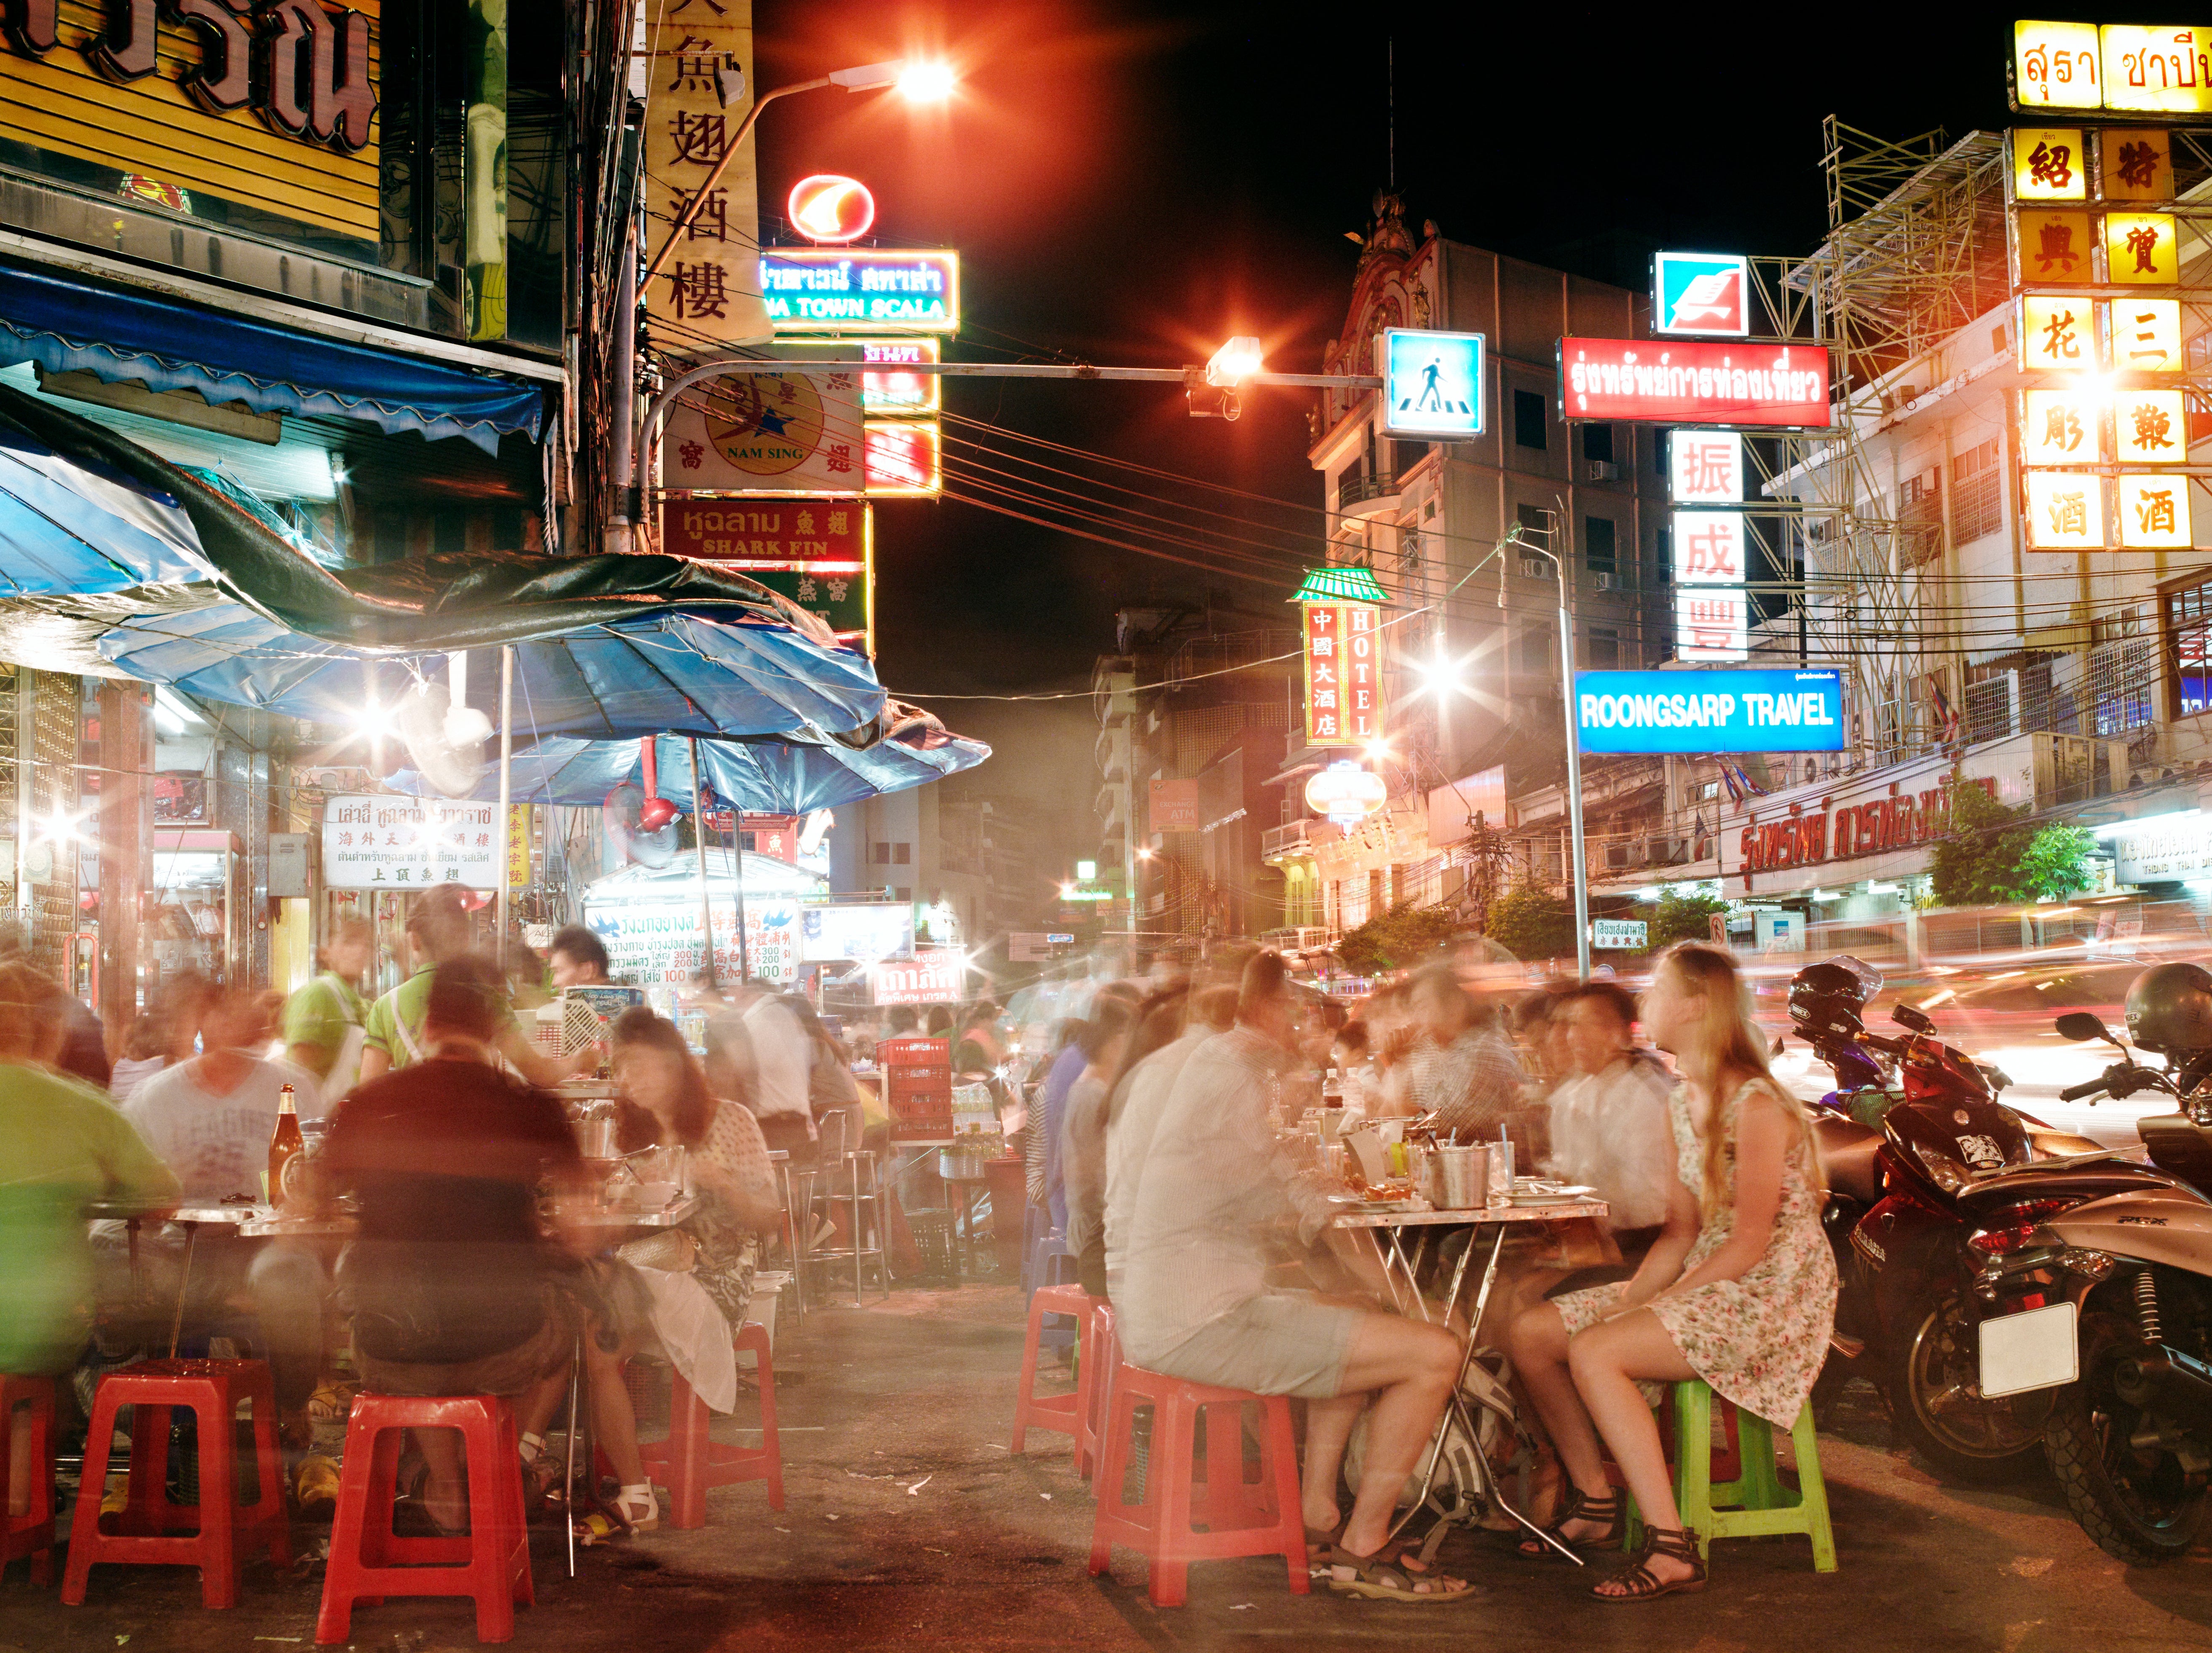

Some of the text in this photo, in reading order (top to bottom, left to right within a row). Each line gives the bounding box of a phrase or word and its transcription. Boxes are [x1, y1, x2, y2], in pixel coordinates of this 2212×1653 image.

[2025, 43, 2095, 100] สุรา
[765, 297, 945, 318] NA TOWN SCALA
[1571, 347, 1820, 410] รุ่งทรัพย์การท่องเที่ยว
[727, 447, 803, 459] NAM SING
[683, 512, 780, 540] หูฉลาม
[703, 540, 828, 556] SHARK FIN
[1313, 610, 1337, 737] 中國大酒店
[1352, 611, 1371, 736] HOTEL
[1580, 692, 1834, 728] ROONGSARP TRAVEL
[439, 806, 492, 825] ยาวราช
[1170, 809, 1195, 820] ATM
[338, 831, 490, 847] 海外天魚酒樓
[767, 834, 783, 860] 魚
[2142, 863, 2169, 874] THONG
[2175, 859, 2194, 871] THAI
[674, 951, 692, 959] 300
[762, 947, 779, 955] 300
[674, 959, 692, 968] 200
[762, 955, 779, 964] 200
[664, 970, 686, 982] 100
[758, 965, 779, 978] 100
[949, 991, 958, 999] A
